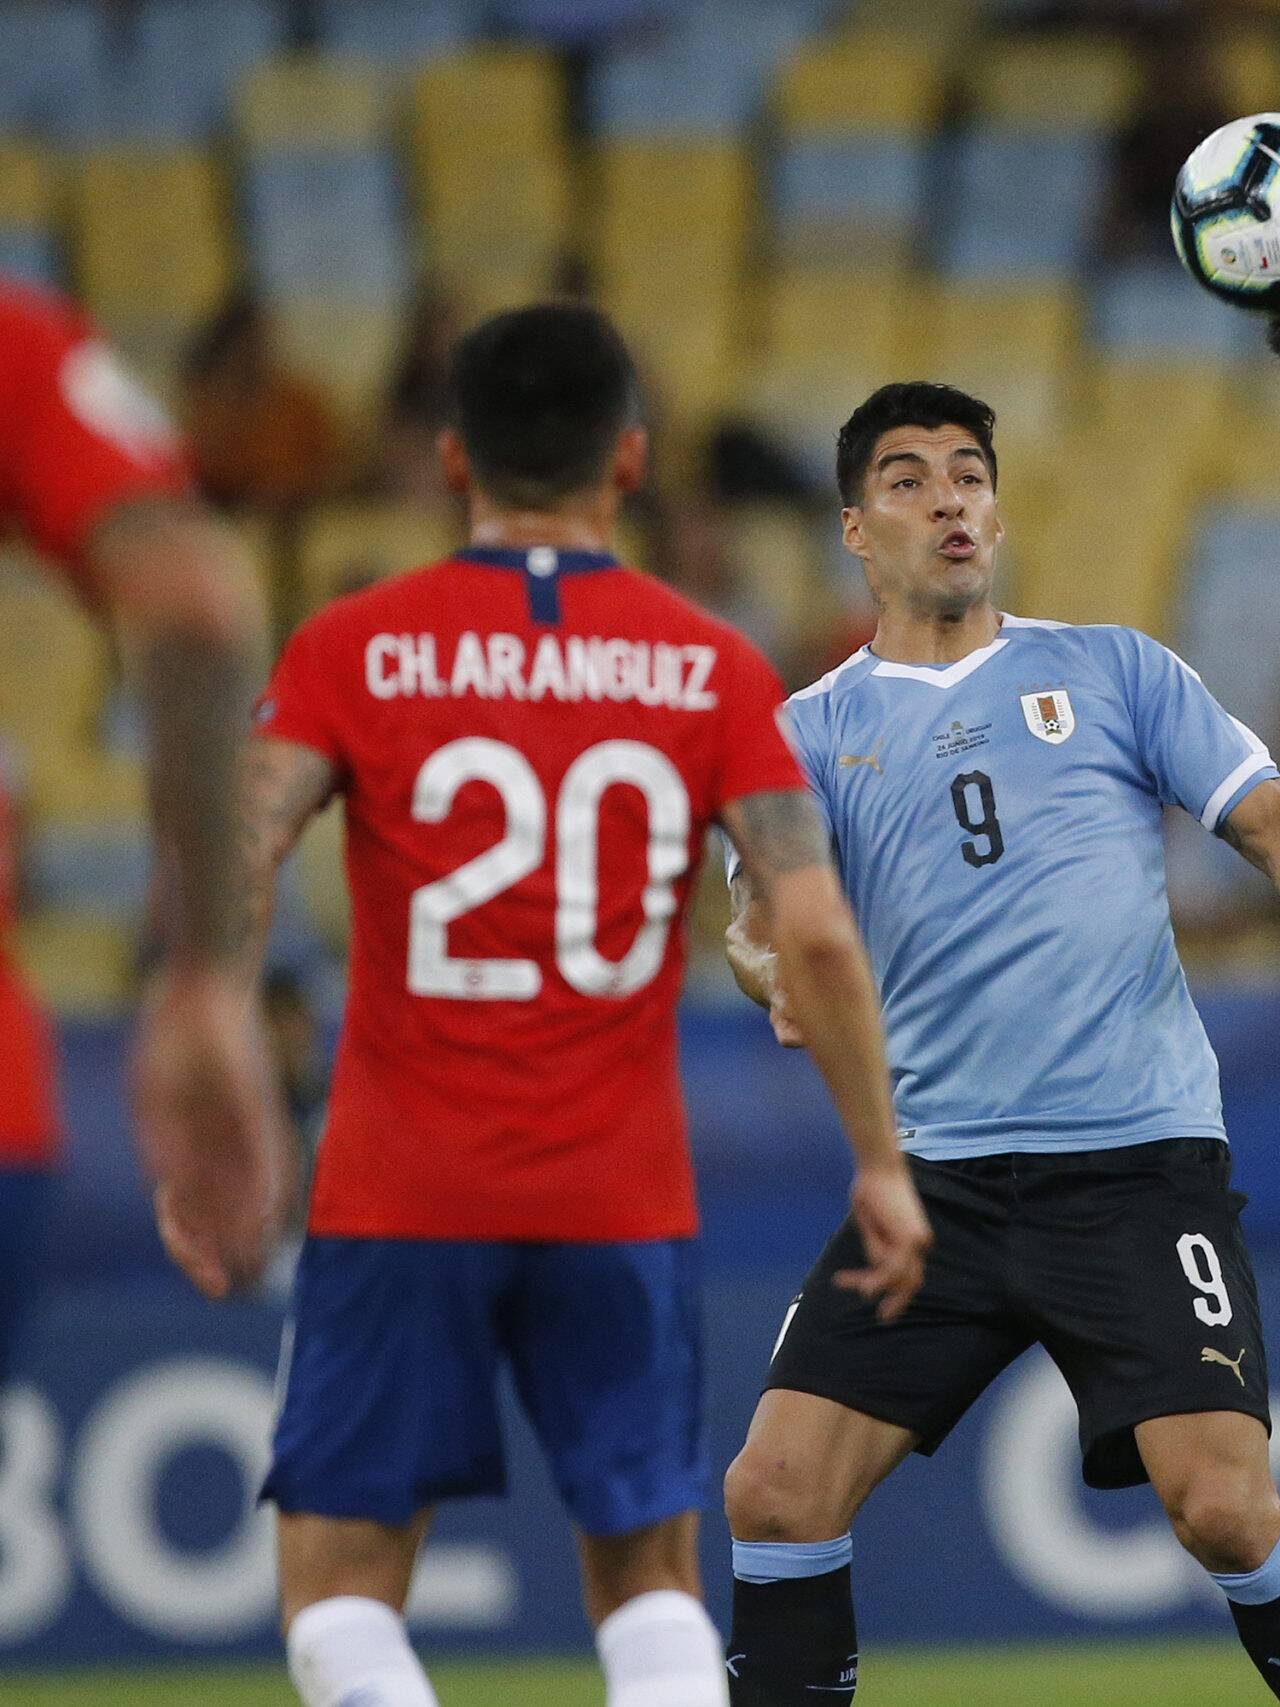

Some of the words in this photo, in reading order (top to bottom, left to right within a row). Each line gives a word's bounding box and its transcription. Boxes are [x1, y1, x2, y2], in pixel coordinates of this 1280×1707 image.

[364, 630, 719, 712] CH.ARANGUIZ
[406, 735, 693, 999] 20
[950, 769, 1005, 869] 9
[1175, 1232, 1233, 1328] 9
